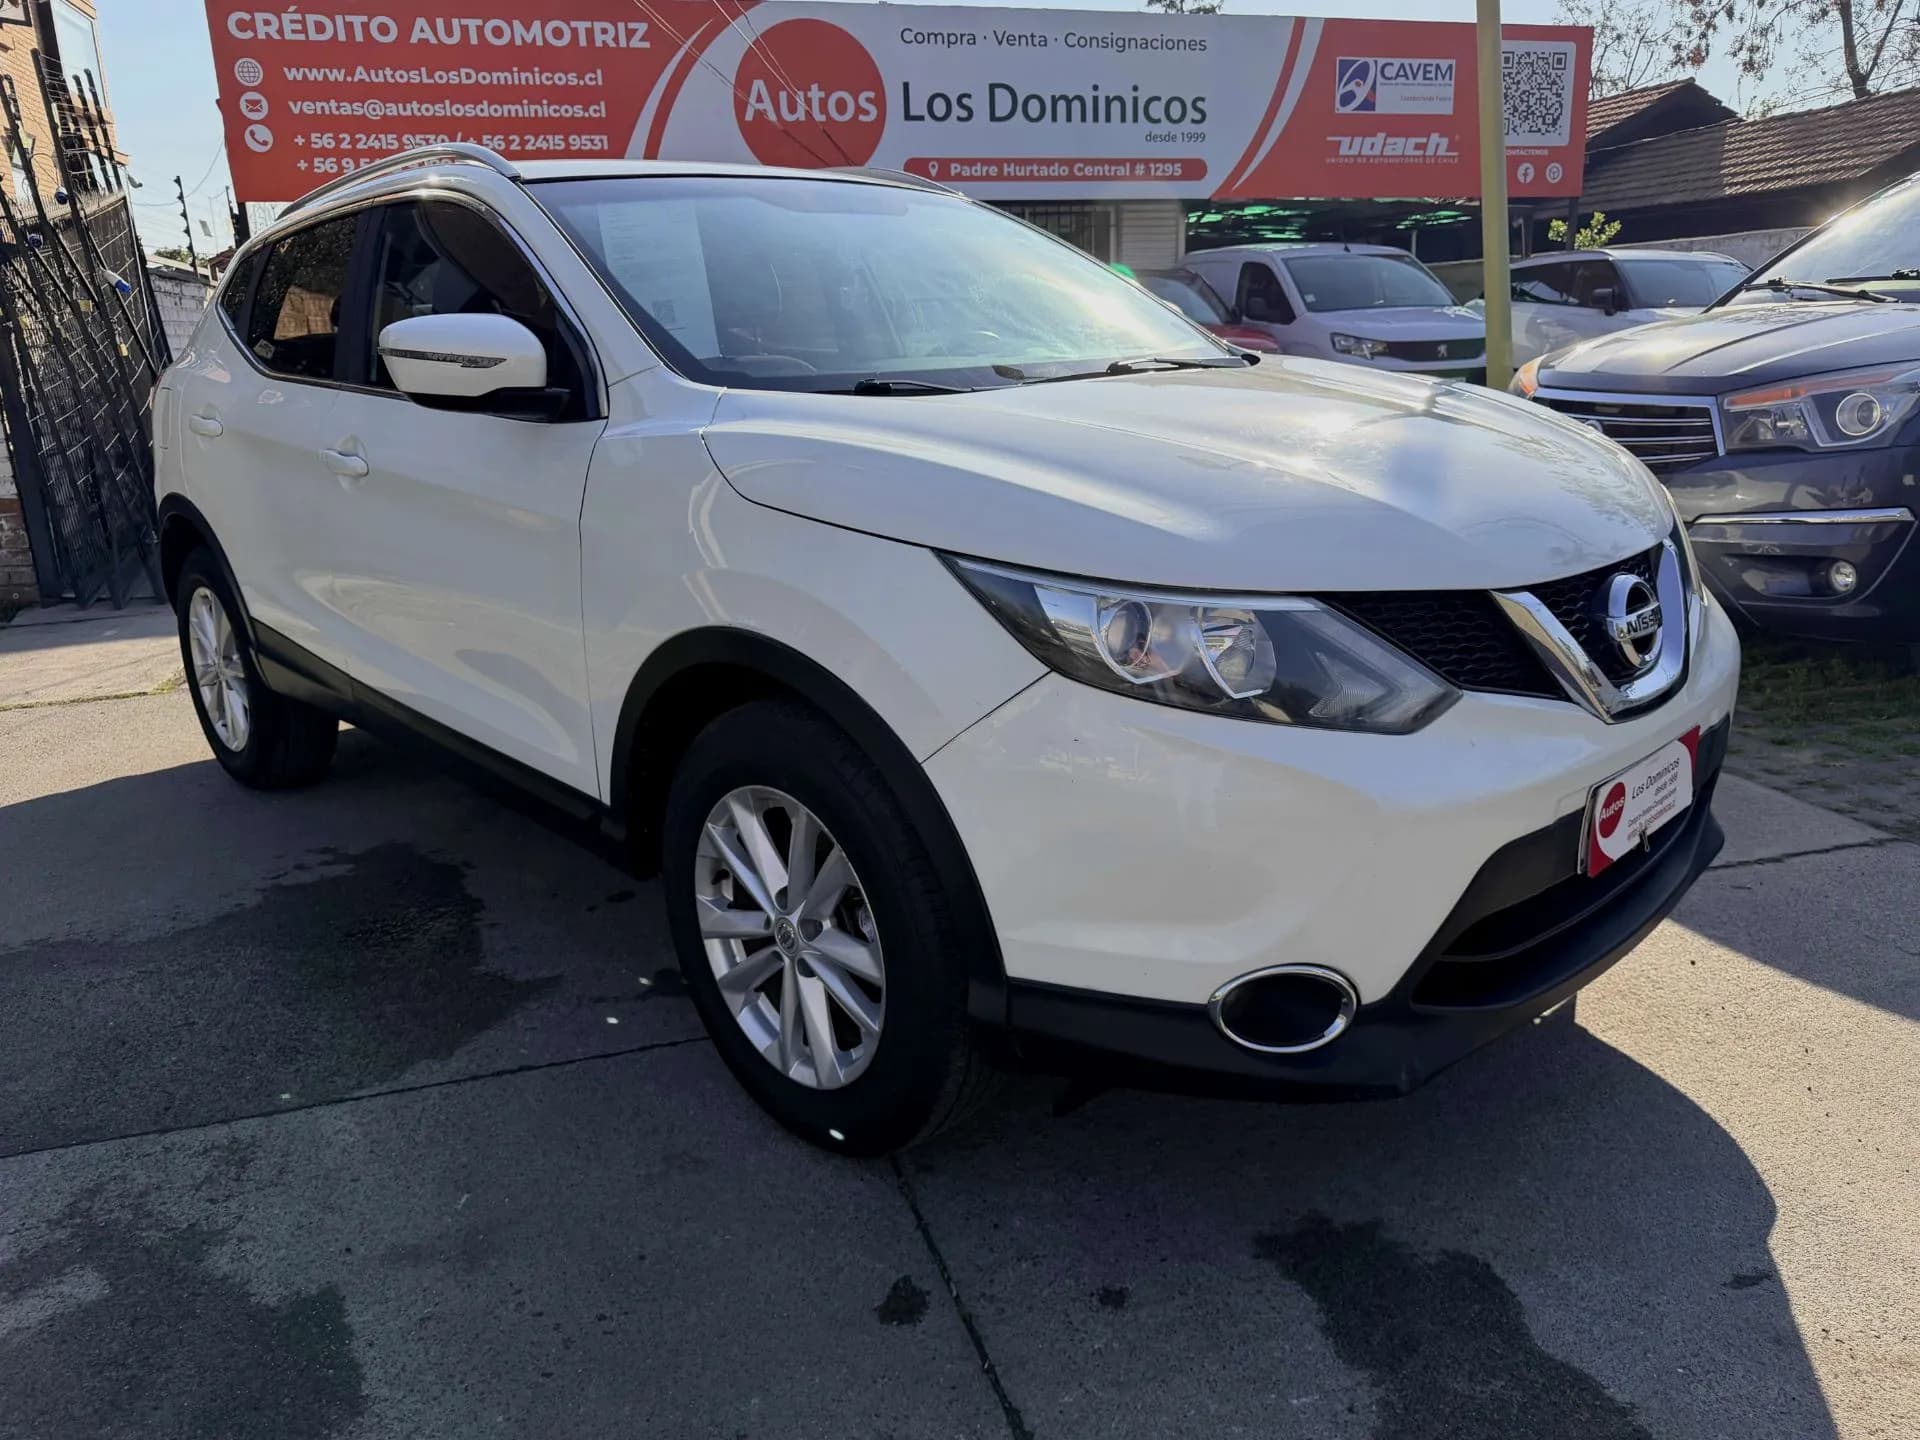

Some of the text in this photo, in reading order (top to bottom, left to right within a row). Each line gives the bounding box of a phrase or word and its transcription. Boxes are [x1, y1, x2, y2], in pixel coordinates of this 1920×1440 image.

[227, 6, 651, 49] CRÉDITO AUTOMOTRIZ
[900, 28, 1207, 54] Compra Venta Consignaciones
[283, 64, 603, 86] www.AutosLosDominicos.cl
[1380, 62, 1453, 81] CAVEM
[288, 98, 607, 120] ventas@autoslosdominicos.cl
[744, 79, 879, 123] Autos
[902, 81, 1208, 126] Los Dominicos
[310, 132, 335, 149] 56
[339, 133, 352, 149] 2
[355, 133, 399, 149] 2415
[482, 134, 505, 150] 56
[509, 134, 521, 150] 2
[524, 134, 565, 150] 2415
[569, 134, 608, 150] 9531
[1145, 131, 1206, 144] desde 1999
[313, 157, 337, 173] 56
[342, 157, 354, 173] 9
[950, 161, 999, 177] Padre
[1003, 161, 1069, 177] Hurtado
[1073, 162, 1132, 177] Central
[1149, 162, 1182, 177] 1295
